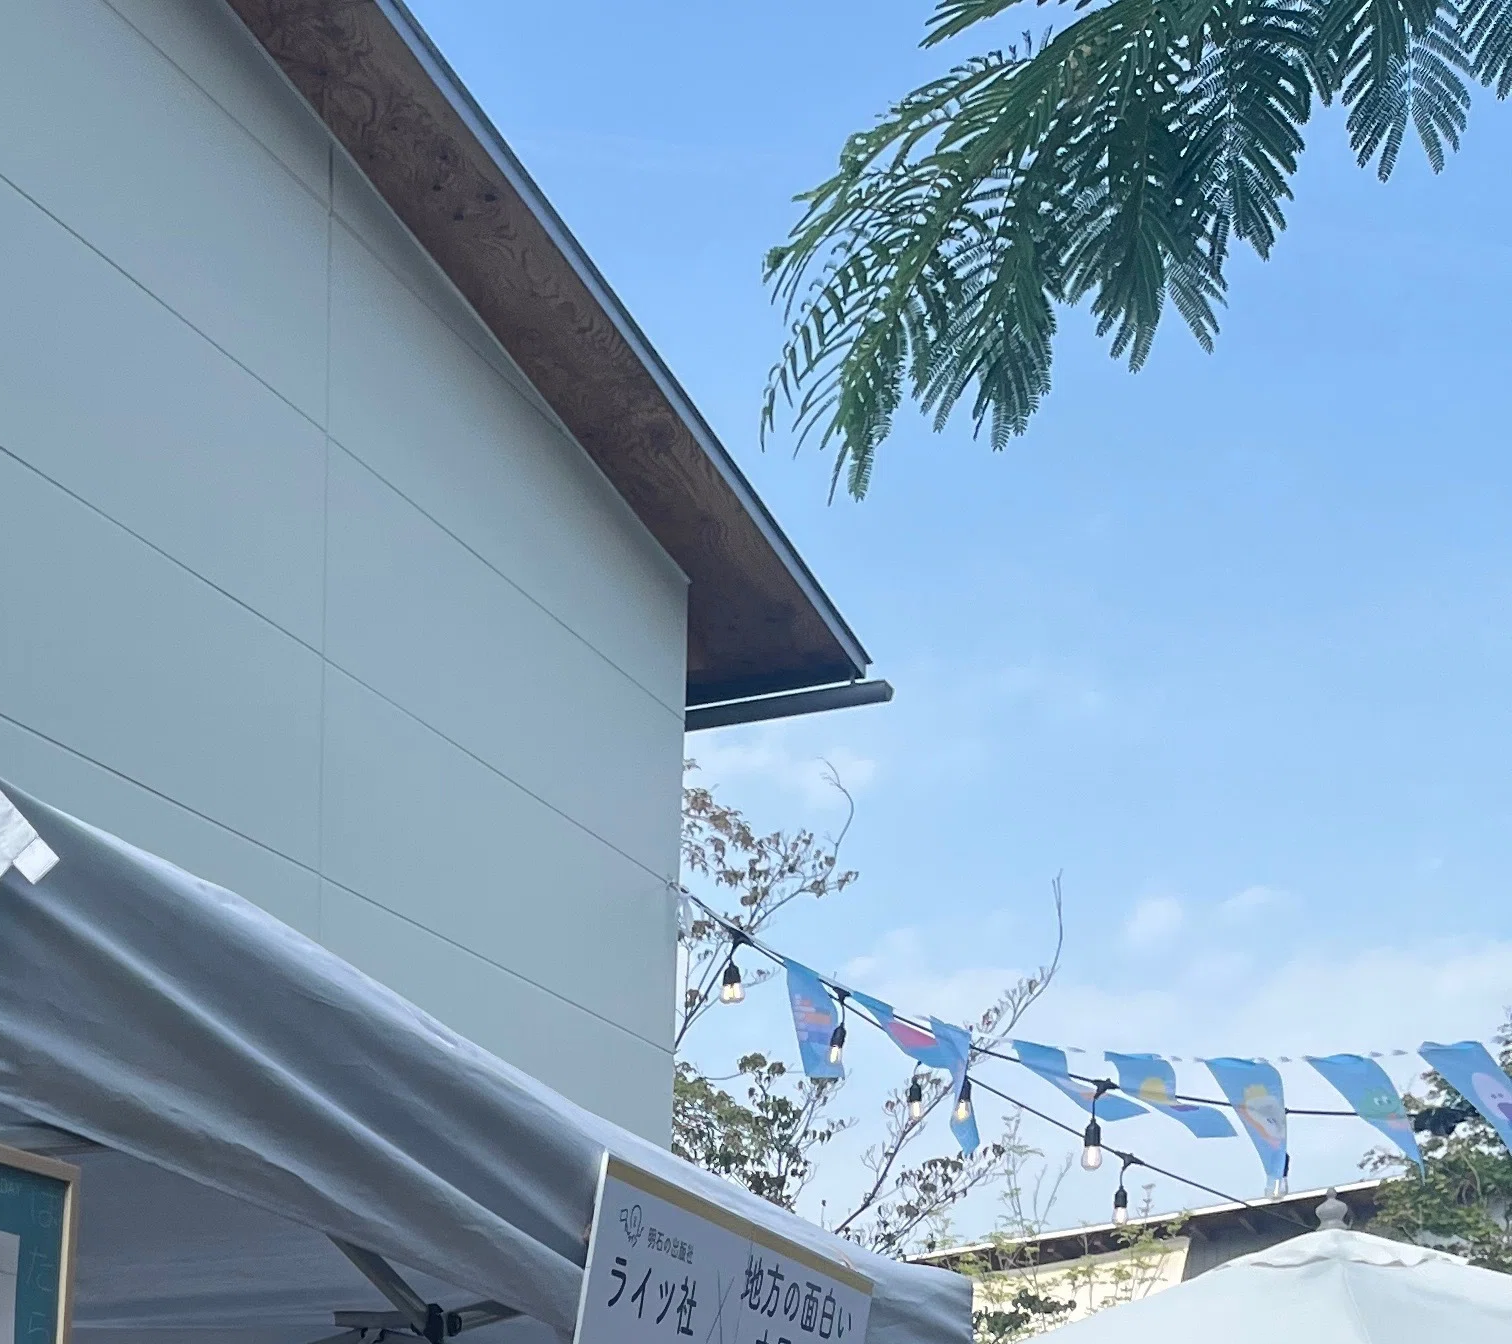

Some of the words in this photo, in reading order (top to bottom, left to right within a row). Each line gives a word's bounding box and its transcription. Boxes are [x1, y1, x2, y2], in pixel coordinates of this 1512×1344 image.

[608, 1256, 697, 1336] ライツ社
[740, 1254, 852, 1340] 地方の面白い
